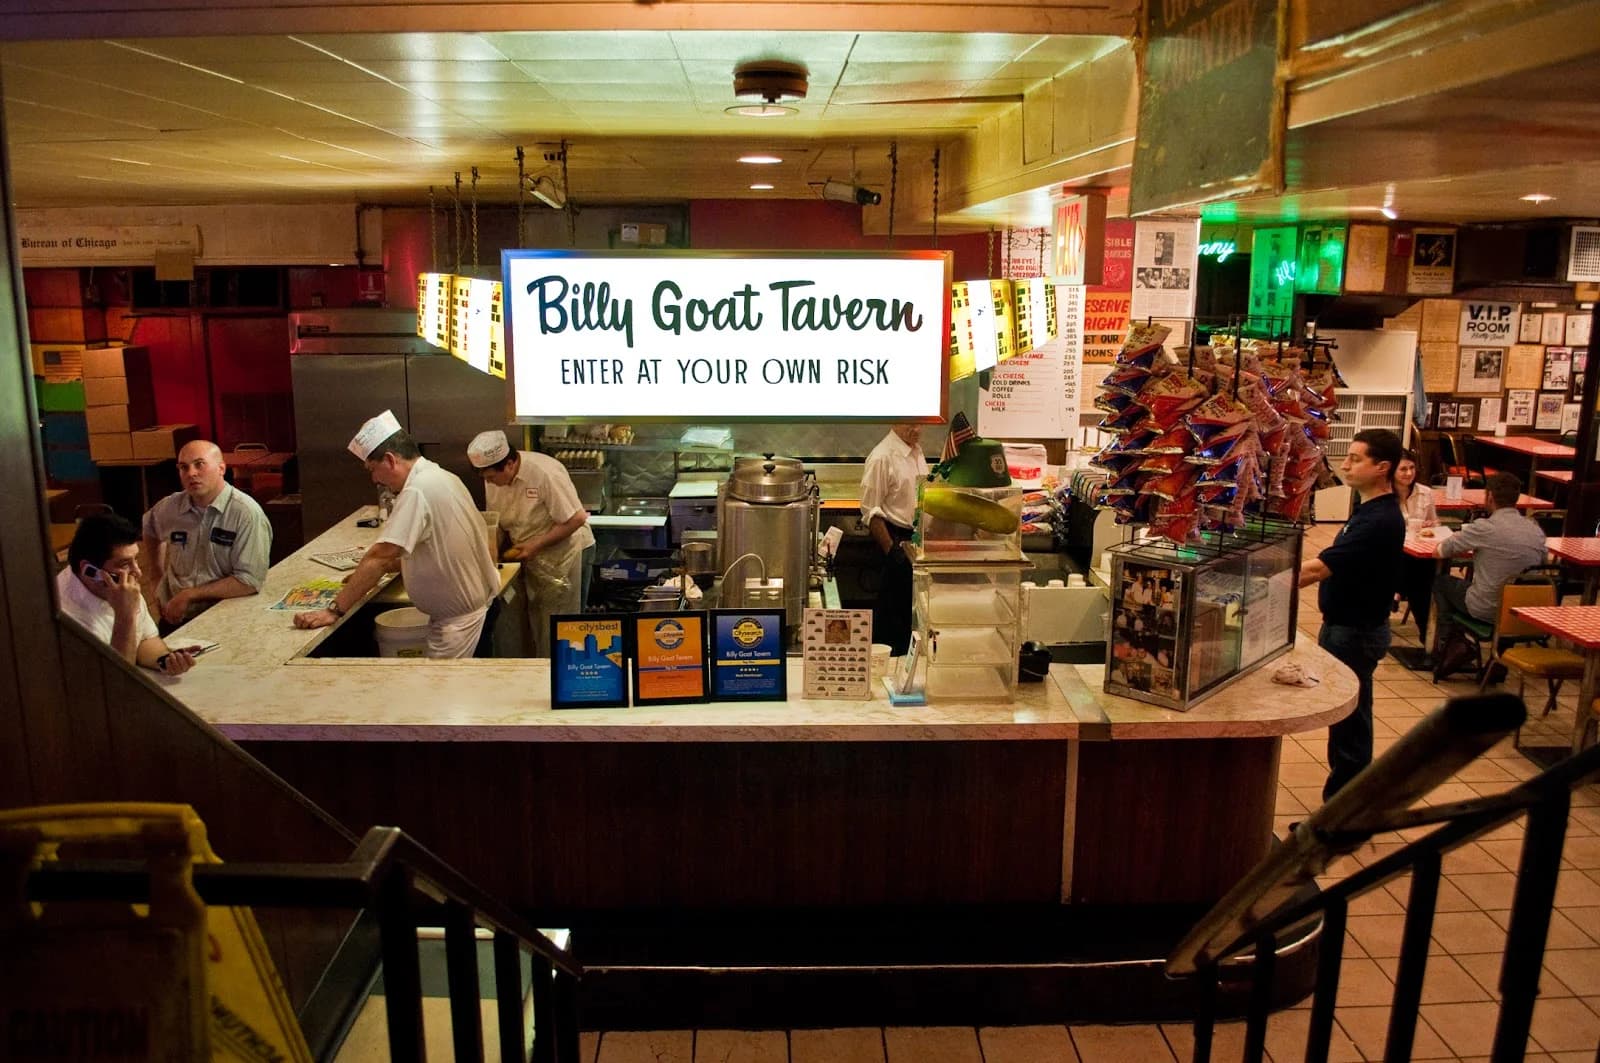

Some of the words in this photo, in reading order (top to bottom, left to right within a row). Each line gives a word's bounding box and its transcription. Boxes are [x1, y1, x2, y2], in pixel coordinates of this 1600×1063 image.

[21, 237, 58, 249] Bureau
[61, 237, 73, 249] of
[75, 237, 117, 250] Chicago
[527, 275, 634, 348] Billy
[652, 280, 763, 335] Goat
[770, 280, 923, 333] Tavern
[1085, 299, 1130, 313] ESERVE
[1469, 304, 1511, 321] V.I.P.
[1084, 316, 1125, 330] RIGHT
[1466, 322, 1510, 333] ROOM
[1100, 334, 1119, 344] OUR
[561, 359, 625, 384] ENTER
[638, 359, 664, 384] AT
[678, 359, 748, 384] YOUR
[764, 359, 822, 384] OWN
[839, 359, 890, 385] RISK
[660, 654, 675, 662] Goat
[726, 651, 738, 659] Billy
[579, 663, 593, 671] Goat
